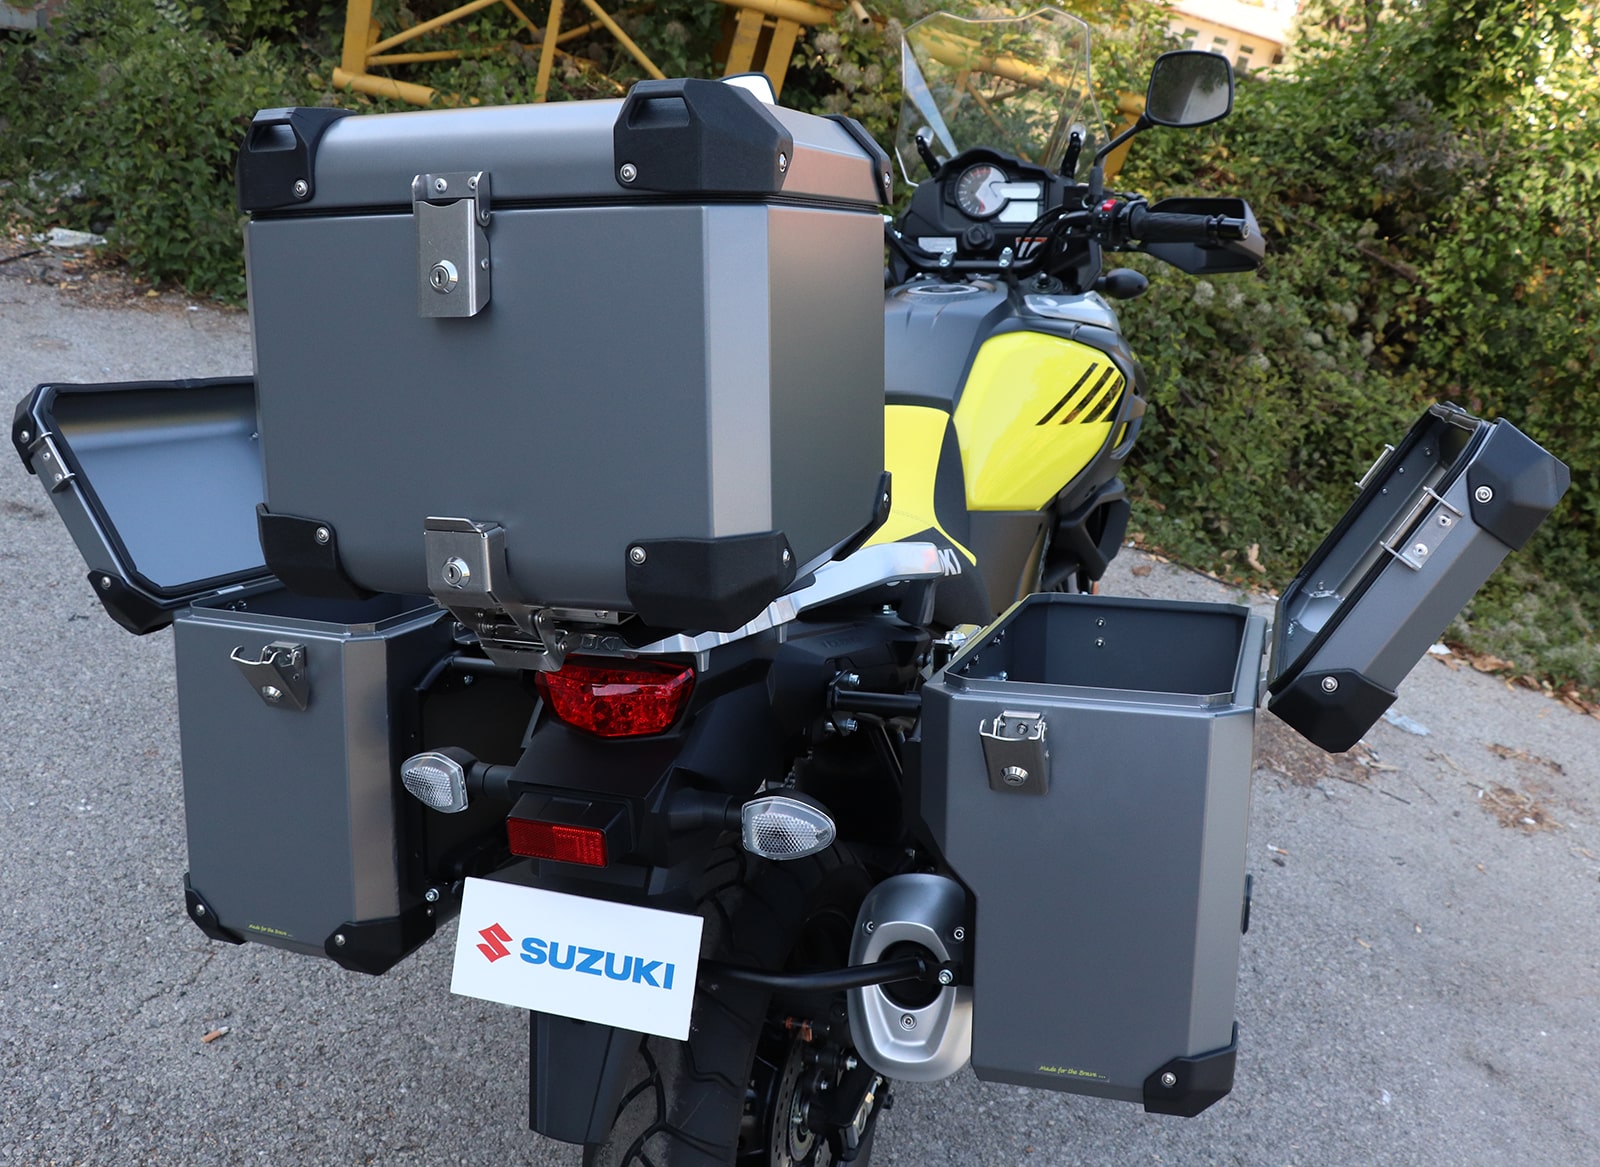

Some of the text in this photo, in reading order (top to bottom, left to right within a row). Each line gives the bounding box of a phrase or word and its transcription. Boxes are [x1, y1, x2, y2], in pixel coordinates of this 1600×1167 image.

[519, 937, 675, 990] SUZUKI
[1039, 1065, 1057, 1073] Made
[1057, 1066, 1067, 1075] for
[1067, 1067, 1078, 1075] the
